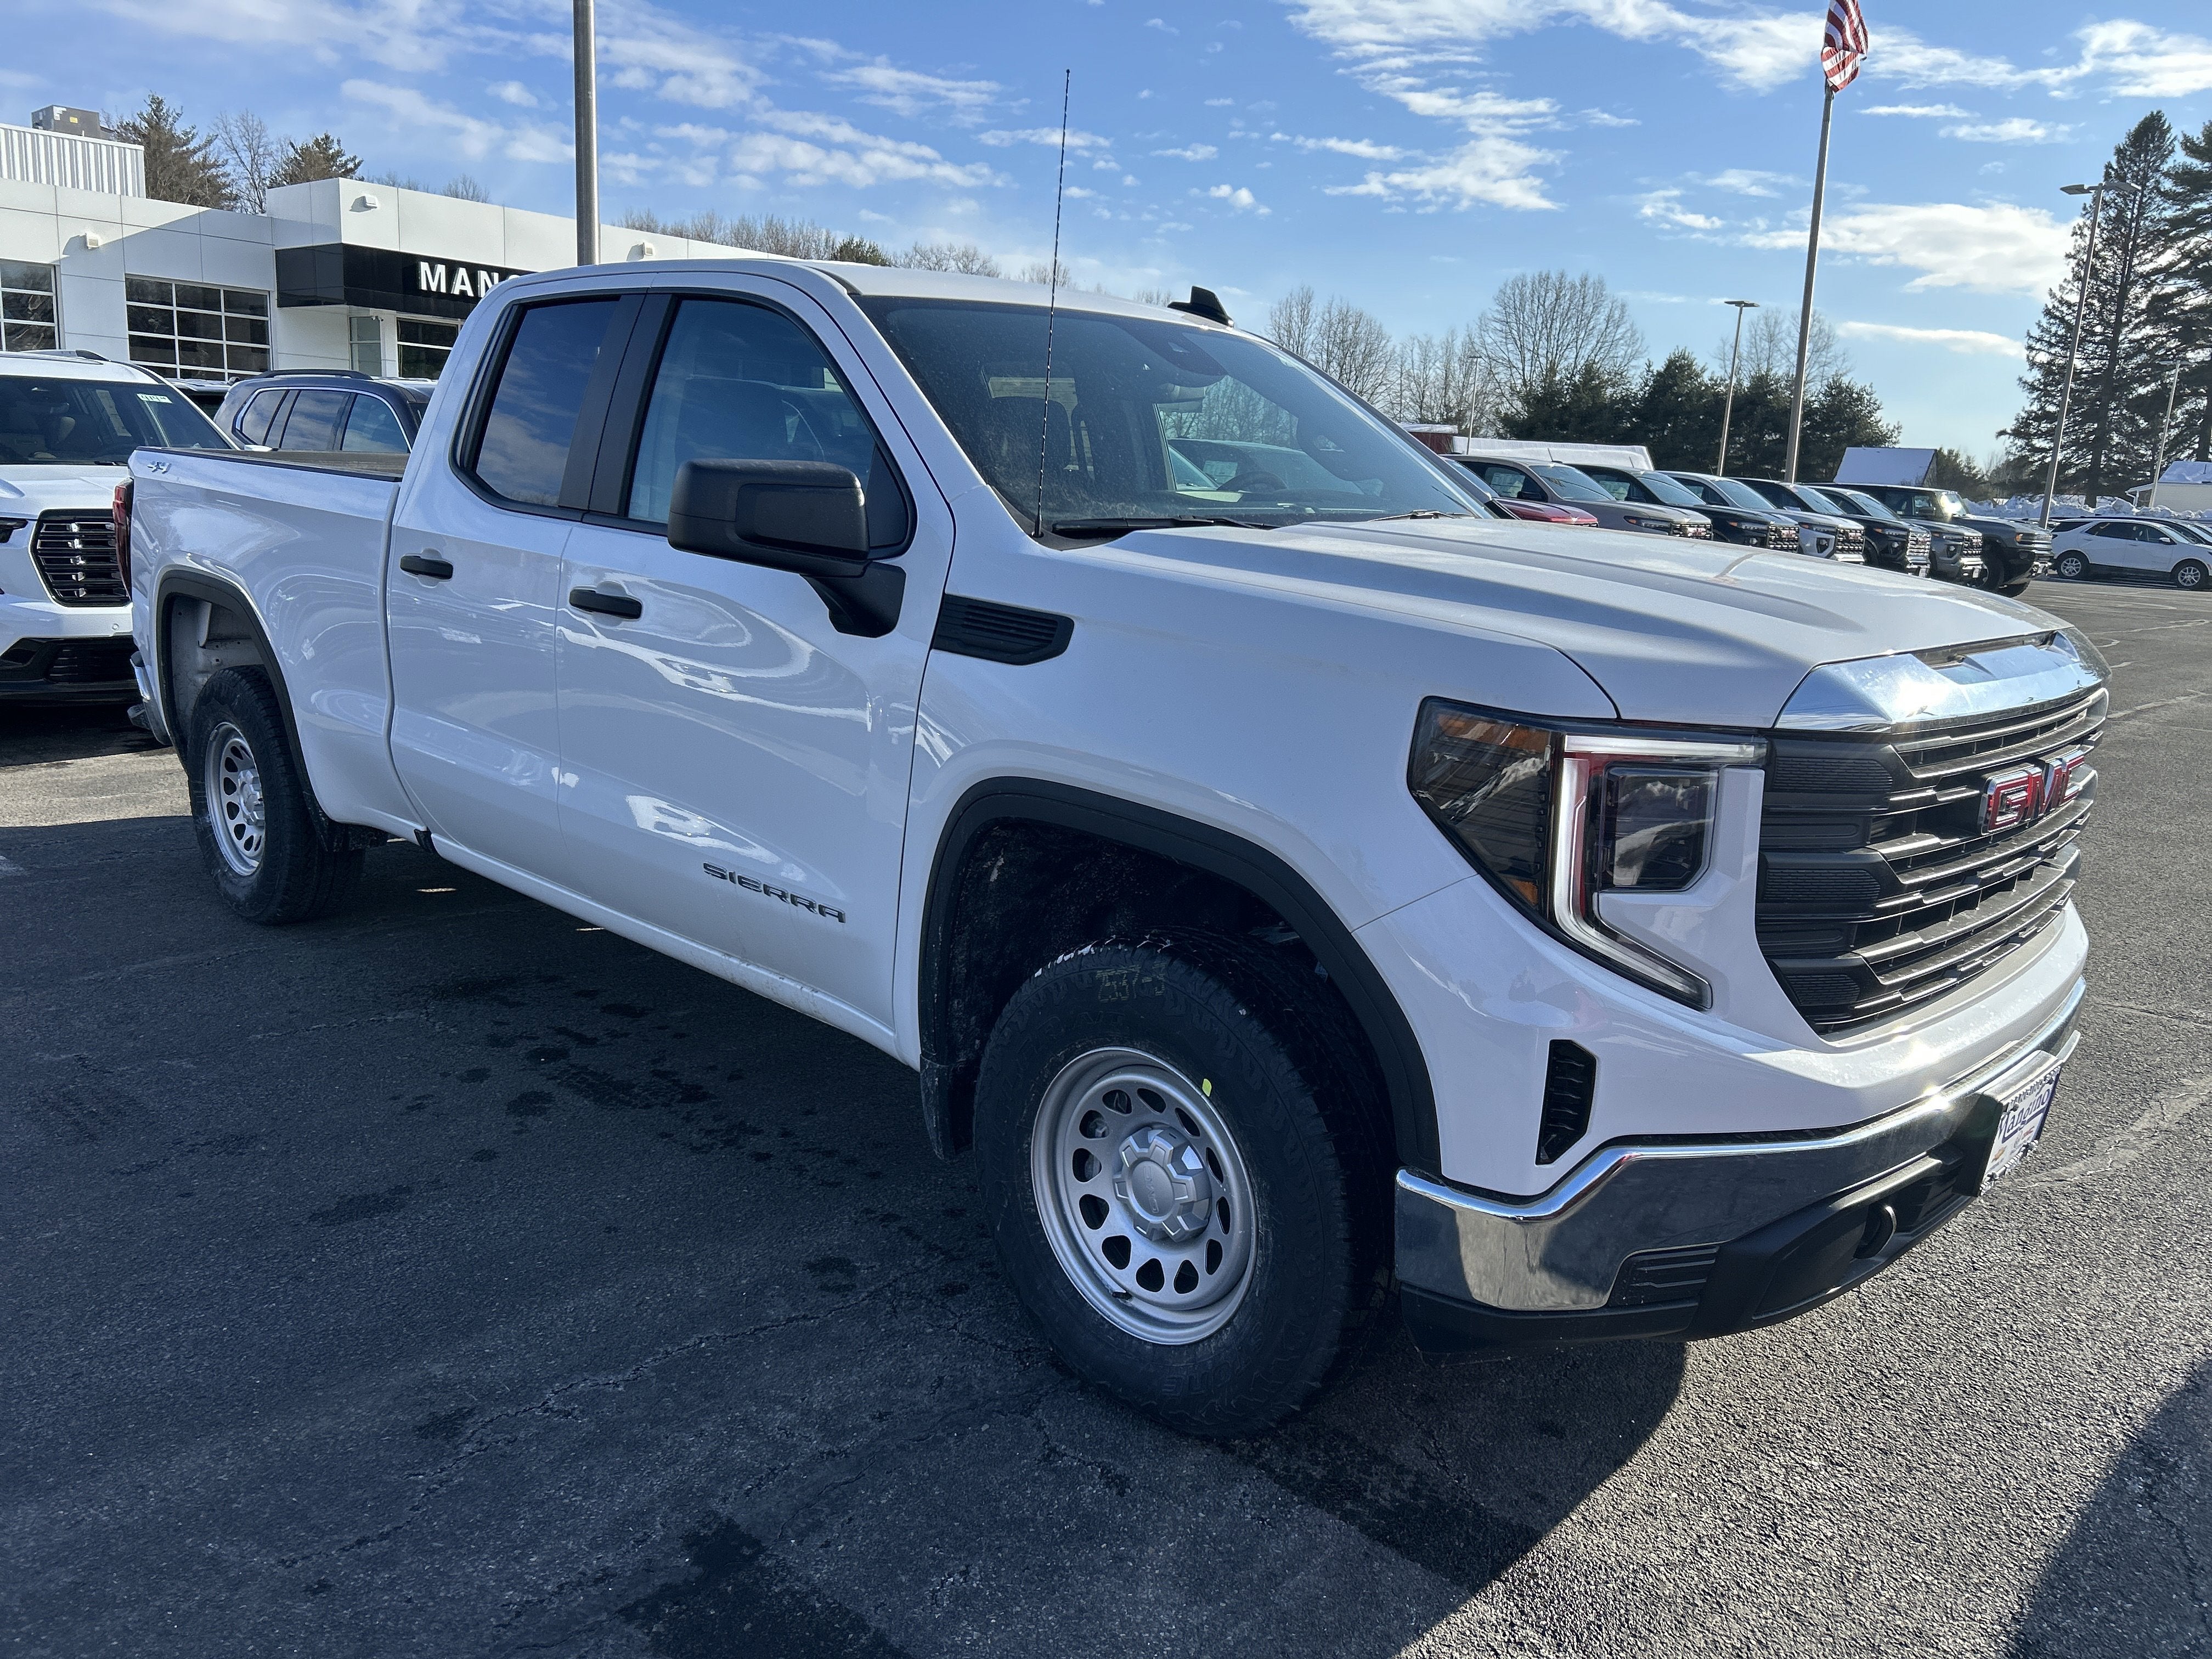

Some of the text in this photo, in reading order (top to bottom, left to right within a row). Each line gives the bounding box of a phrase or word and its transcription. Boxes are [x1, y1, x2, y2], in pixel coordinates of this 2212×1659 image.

[419, 261, 520, 298] MAN
[1978, 749, 2085, 835] GMC
[703, 861, 846, 923] SIERRA
[1143, 1165, 1159, 1214] GMC
